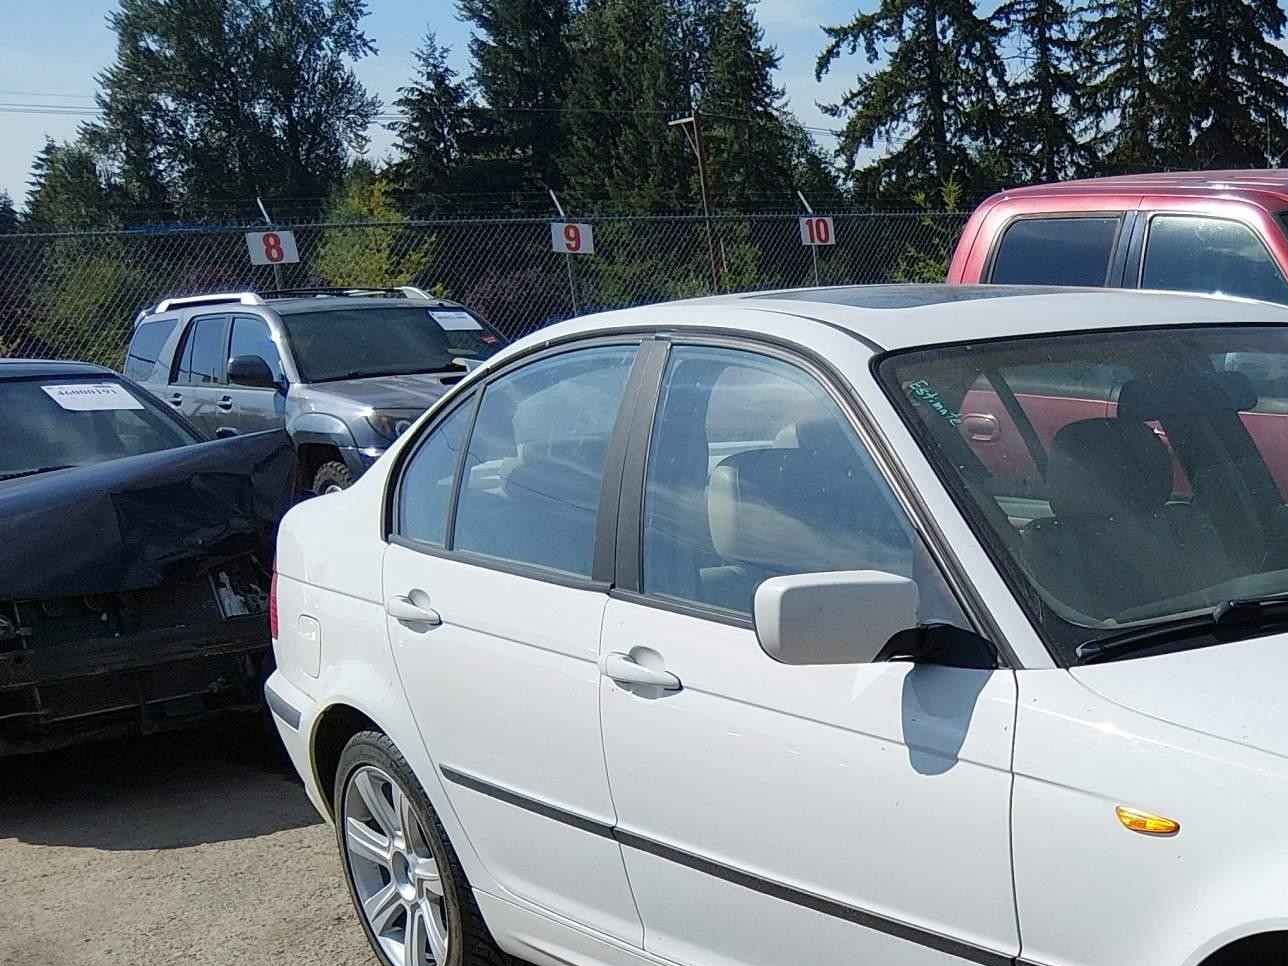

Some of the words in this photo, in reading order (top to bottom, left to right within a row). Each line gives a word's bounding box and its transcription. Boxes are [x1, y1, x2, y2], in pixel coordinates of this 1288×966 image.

[564, 225, 581, 252] 9
[805, 218, 830, 244] 10
[262, 232, 284, 263] 8
[908, 379, 962, 428] Estimate
